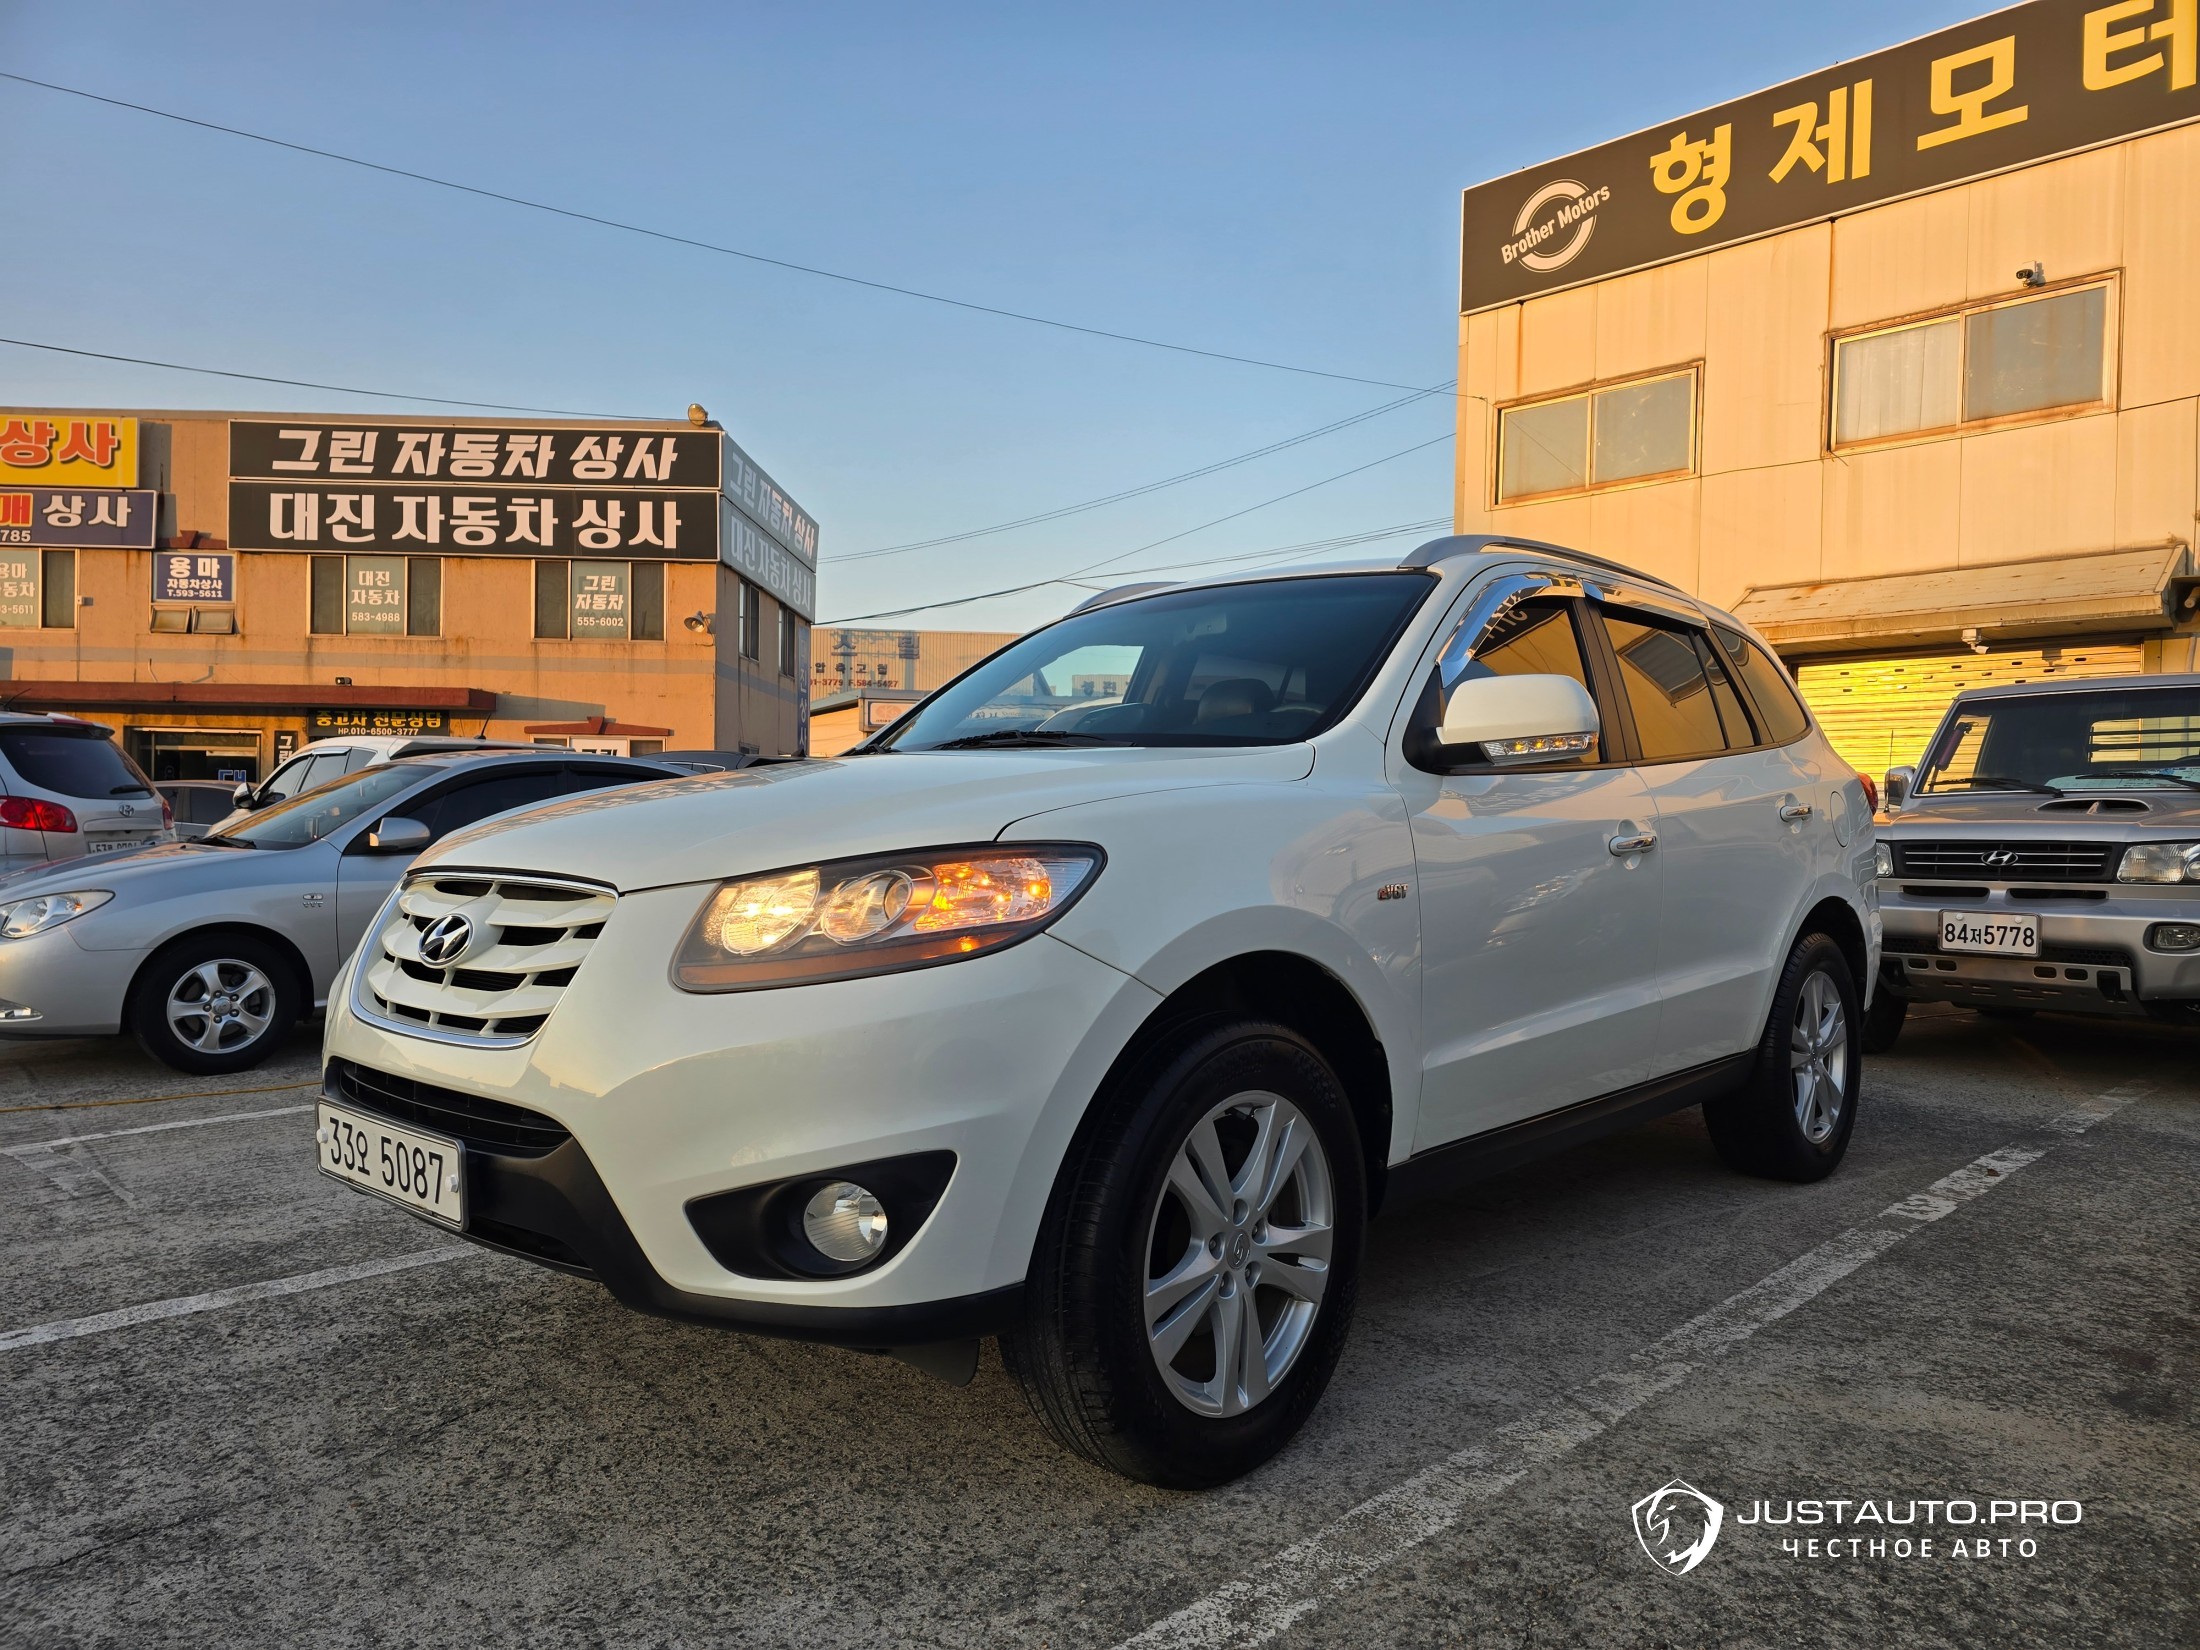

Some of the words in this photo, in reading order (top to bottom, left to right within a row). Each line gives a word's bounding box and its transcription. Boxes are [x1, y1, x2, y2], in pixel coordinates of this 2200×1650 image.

[1501, 219, 1556, 265] Brother
[1557, 185, 1610, 229] Motors
[0, 419, 119, 468] 상사
[272, 429, 379, 474] 그린
[390, 433, 556, 479] 자동차
[569, 436, 679, 481] 상사
[42, 494, 132, 528] 상사
[730, 451, 757, 509] 그린
[757, 478, 794, 540] 자동차
[794, 513, 815, 560] 상사
[269, 492, 376, 543] 대진
[392, 495, 559, 546] 자동차
[571, 499, 682, 549] 상사
[0, 529, 31, 542] 785
[731, 515, 756, 572] 대진
[758, 538, 791, 597] 자동차
[792, 568, 812, 612] 상사
[167, 578, 223, 590] 자동차상사
[358, 570, 390, 587] 대진
[584, 575, 617, 592] 그린
[167, 589, 223, 598] T.593-5611
[350, 589, 400, 606] 자동차
[574, 594, 624, 611] 자동차
[351, 611, 401, 622] 583-4988
[577, 616, 624, 627] 555-6002
[316, 710, 368, 727] 중고차
[373, 711, 443, 728] 전문상담
[338, 727, 419, 736] HP.010-6500-3777
[1944, 923, 2035, 947] 84저5778
[329, 1116, 371, 1176] 33오
[380, 1135, 444, 1205] 5087
